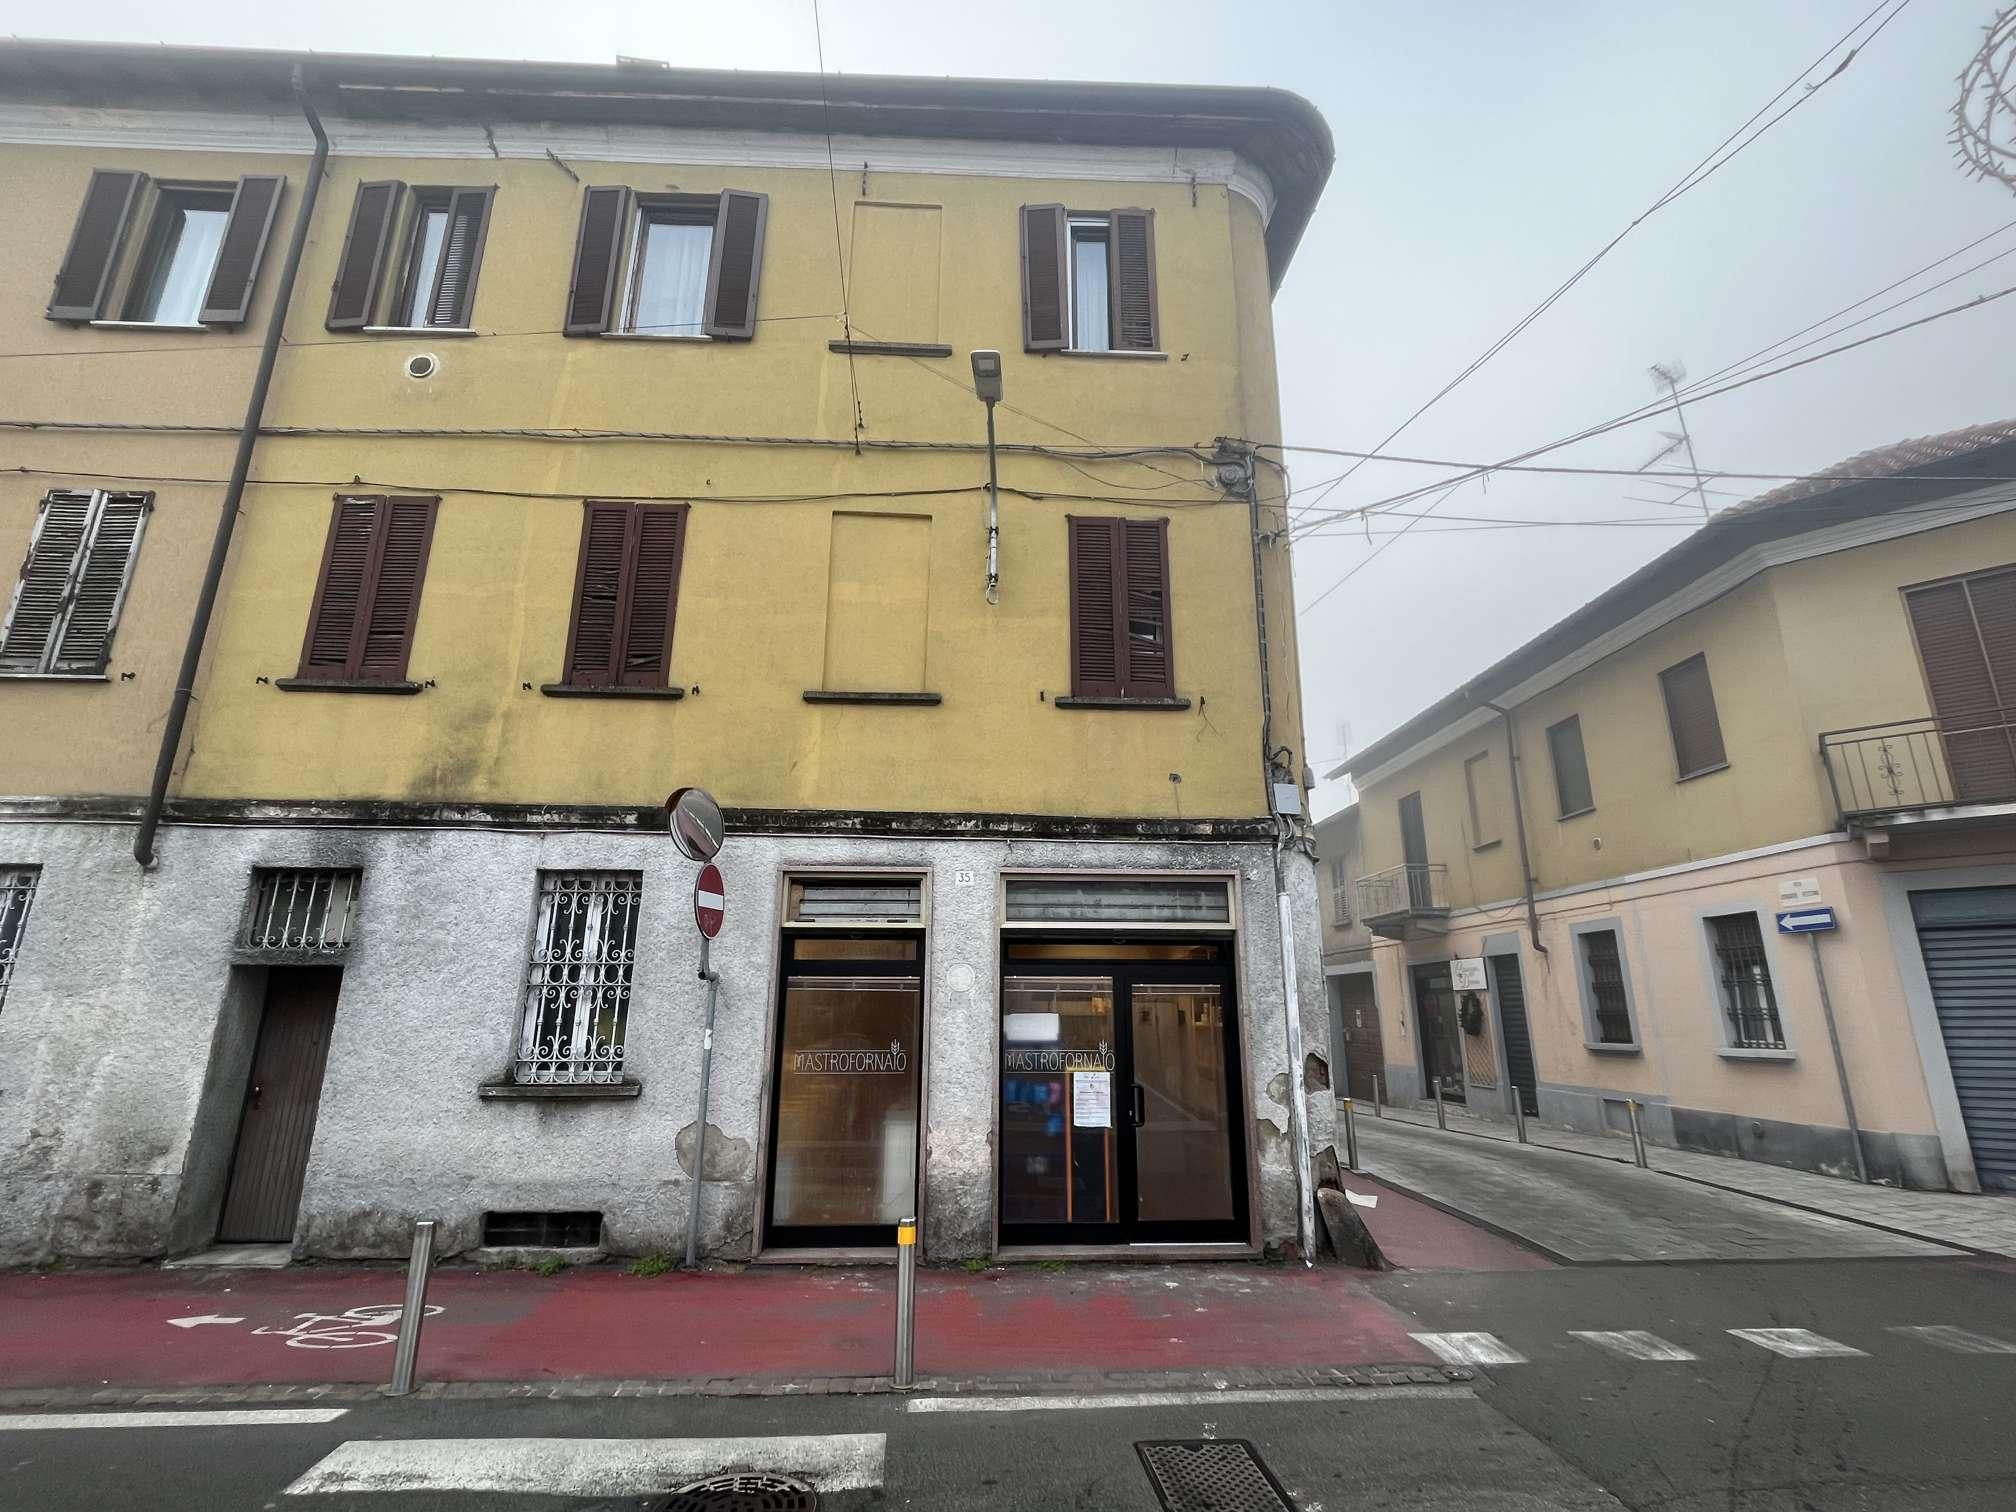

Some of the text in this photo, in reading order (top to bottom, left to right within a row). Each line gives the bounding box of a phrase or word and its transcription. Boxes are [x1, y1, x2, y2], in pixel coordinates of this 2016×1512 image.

[958, 872, 971, 883] 35
[793, 1051, 907, 1072] MASTROFORNAIO
[1004, 1050, 1115, 1071] MASTROFORNAIO
